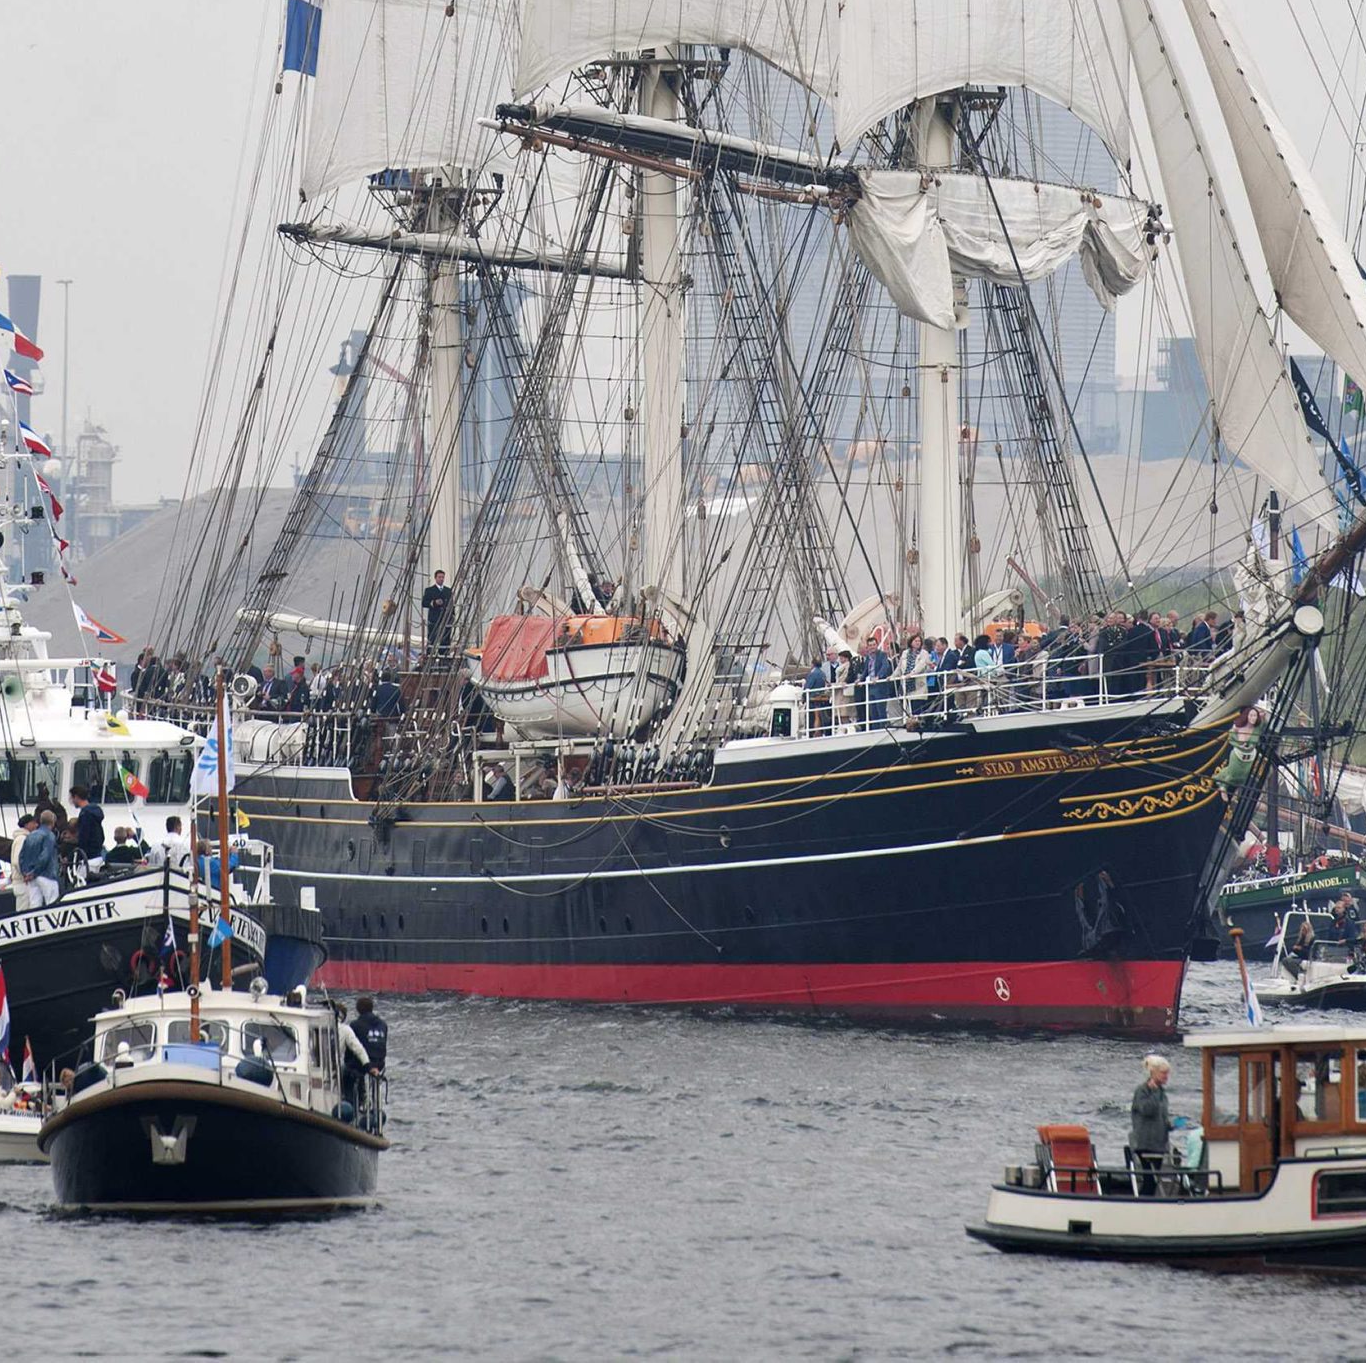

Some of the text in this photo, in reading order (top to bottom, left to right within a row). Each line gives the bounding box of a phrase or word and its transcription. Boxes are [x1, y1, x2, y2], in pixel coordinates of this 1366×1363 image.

[983, 752, 1102, 776] STAD AMSTERDAM
[1283, 876, 1342, 895] HOUTHANDEL
